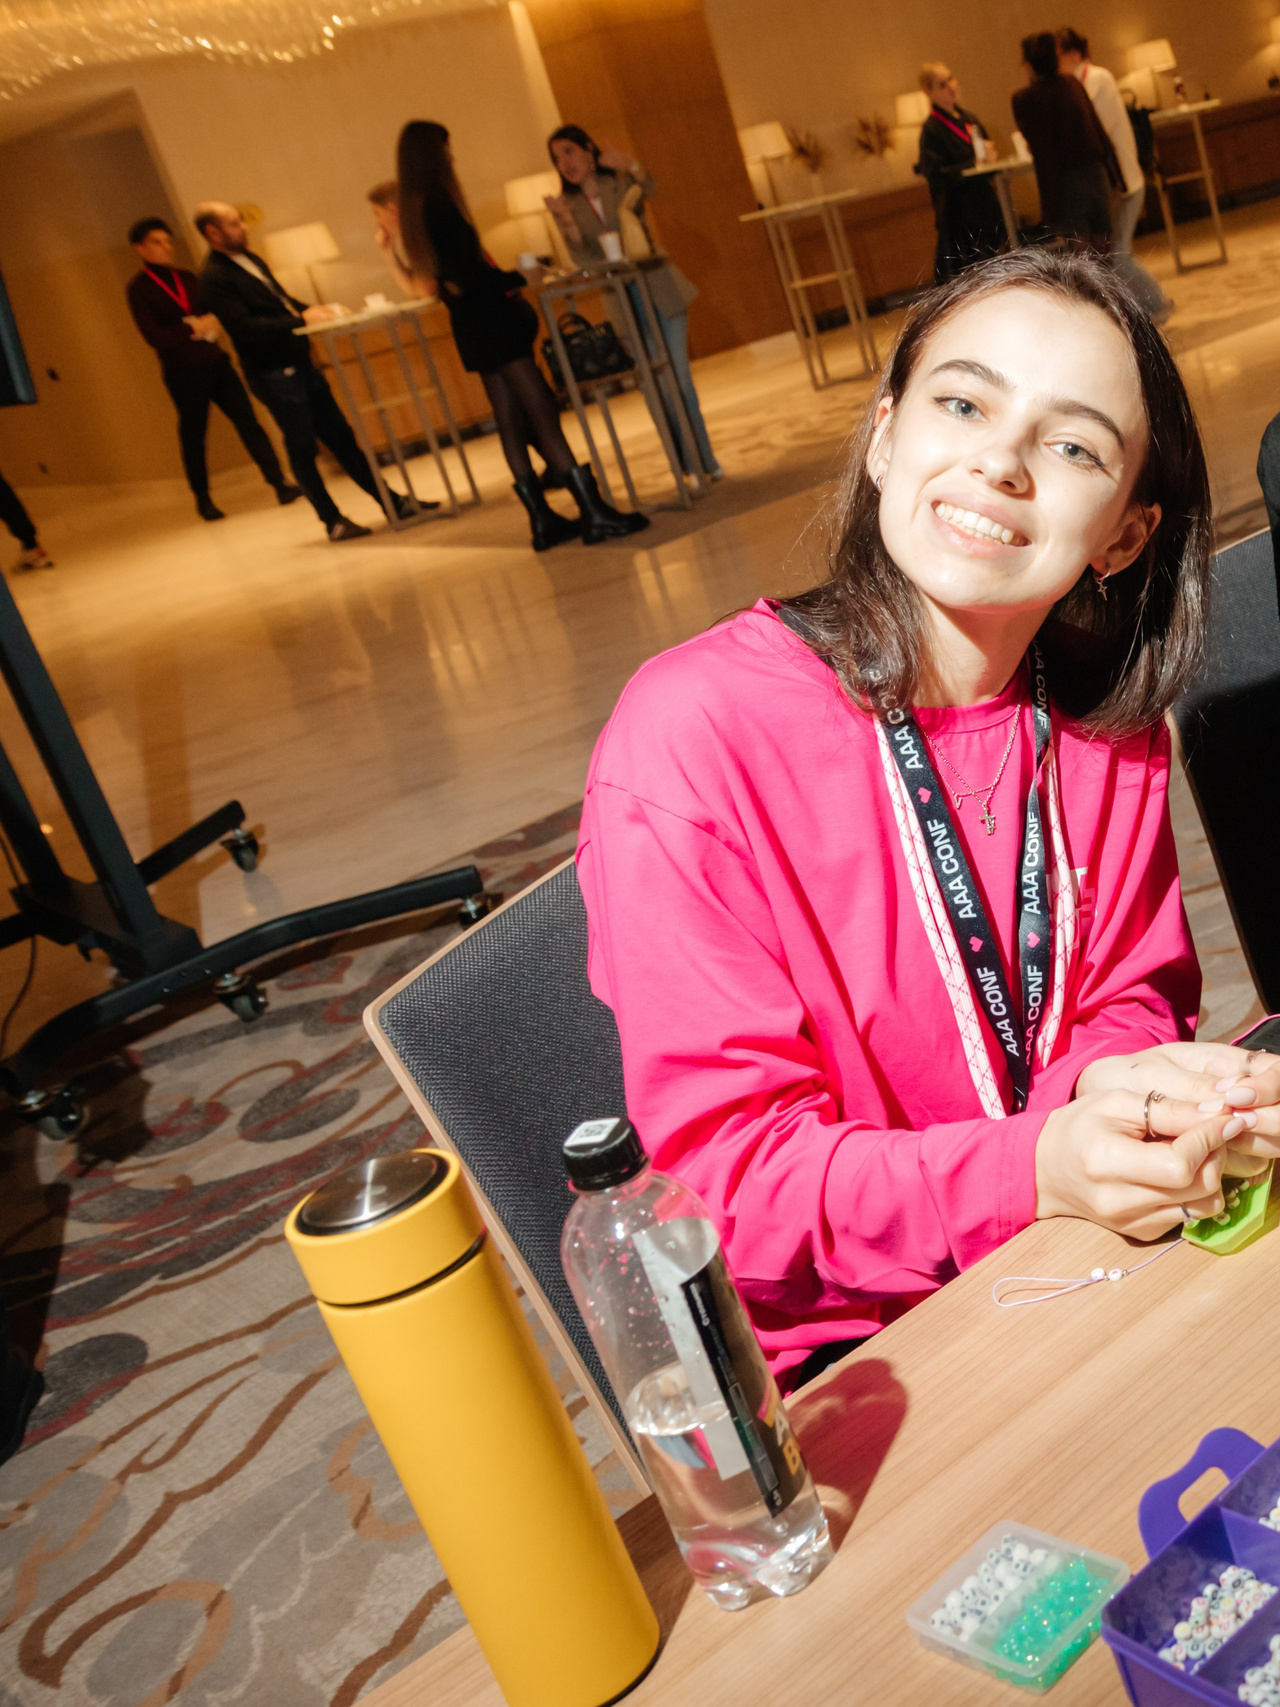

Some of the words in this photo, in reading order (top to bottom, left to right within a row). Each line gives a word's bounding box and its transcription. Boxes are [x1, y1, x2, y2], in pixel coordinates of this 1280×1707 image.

[1036, 674, 1047, 729] CONF
[893, 724, 924, 769] AAA
[926, 818, 959, 875] CONF
[1024, 811, 1040, 867] CONF
[947, 869, 977, 919] AAA
[1020, 870, 1041, 915] AAA
[976, 966, 1006, 1017] CONF
[1026, 964, 1043, 1018] CONF
[994, 1018, 1020, 1057] AAA
[1025, 1019, 1036, 1066] AAA
